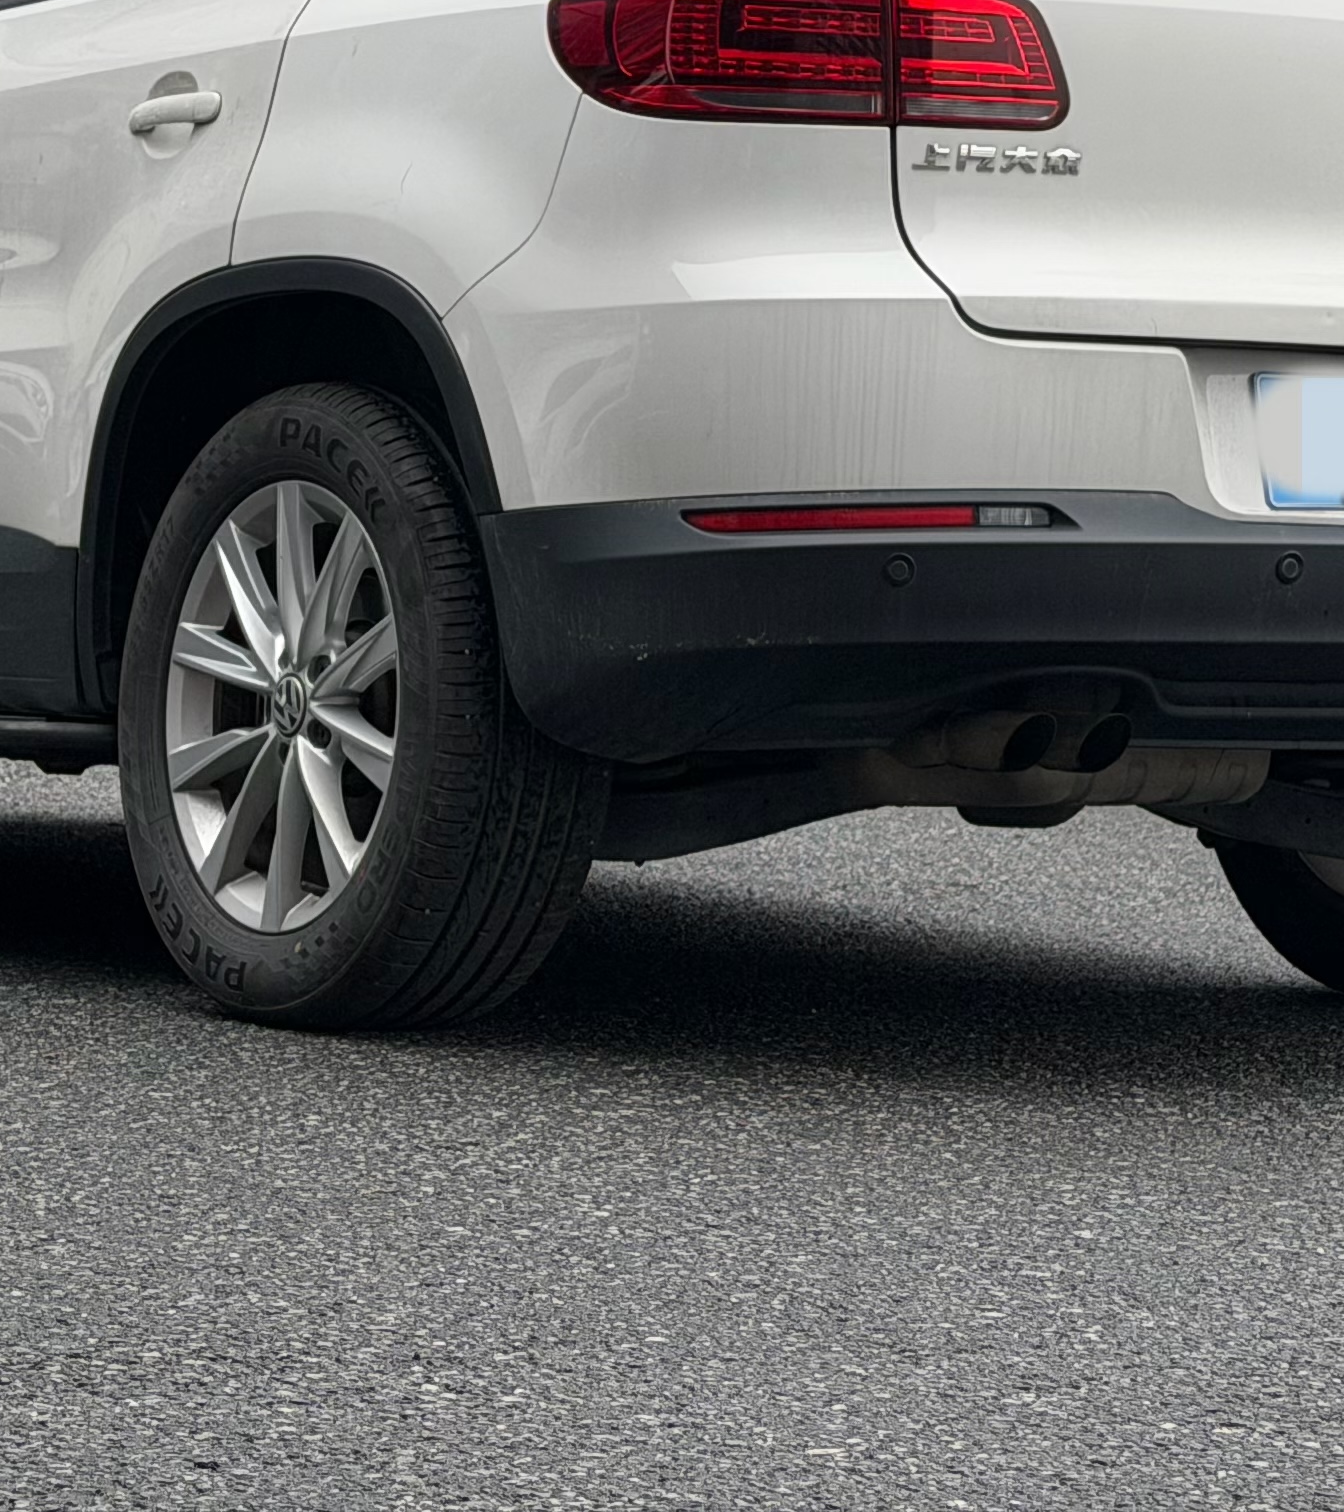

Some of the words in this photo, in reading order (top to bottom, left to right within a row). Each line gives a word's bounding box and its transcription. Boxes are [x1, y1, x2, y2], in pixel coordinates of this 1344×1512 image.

[910, 142, 1083, 177] 上汽大众
[278, 416, 367, 501] PACE
